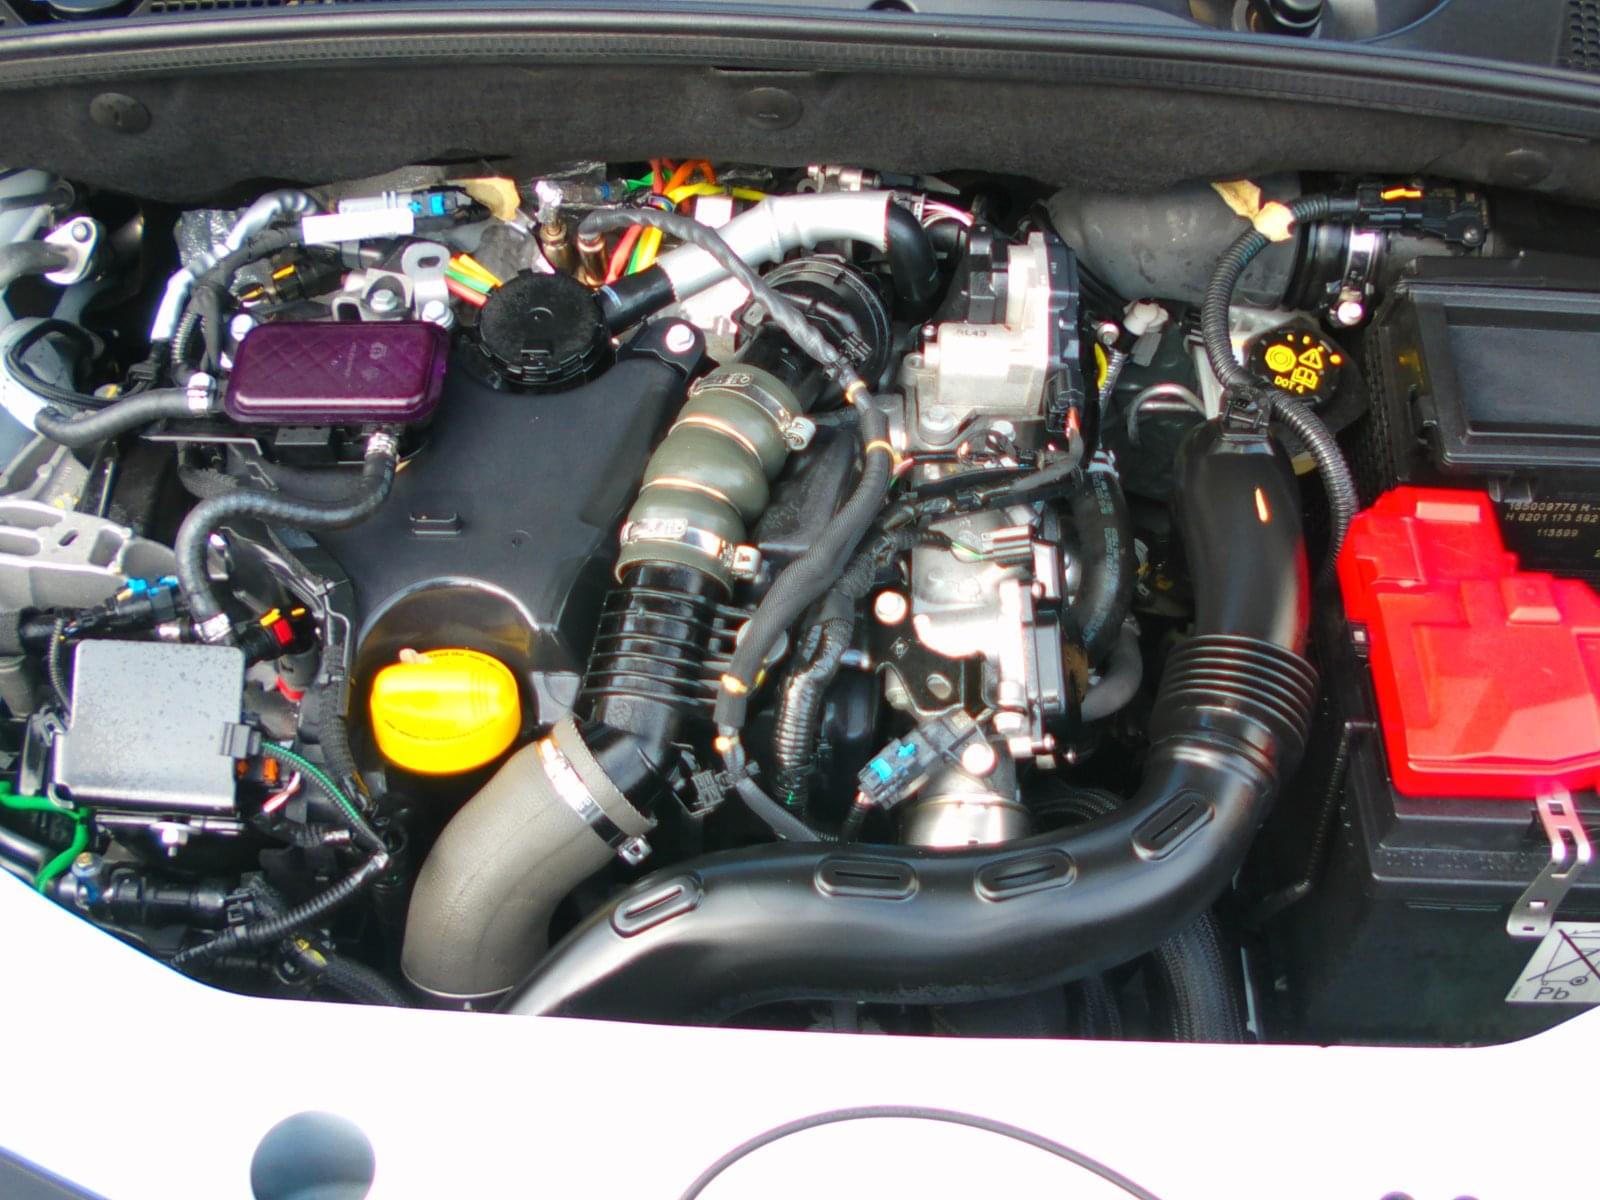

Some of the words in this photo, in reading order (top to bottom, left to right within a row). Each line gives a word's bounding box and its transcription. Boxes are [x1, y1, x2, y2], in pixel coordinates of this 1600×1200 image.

[1274, 375, 1296, 390] DOT
[1296, 384, 1304, 394] 4
[1505, 512, 1515, 520] H
[1552, 514, 1572, 522] 173
[1533, 986, 1570, 1000] Pb
